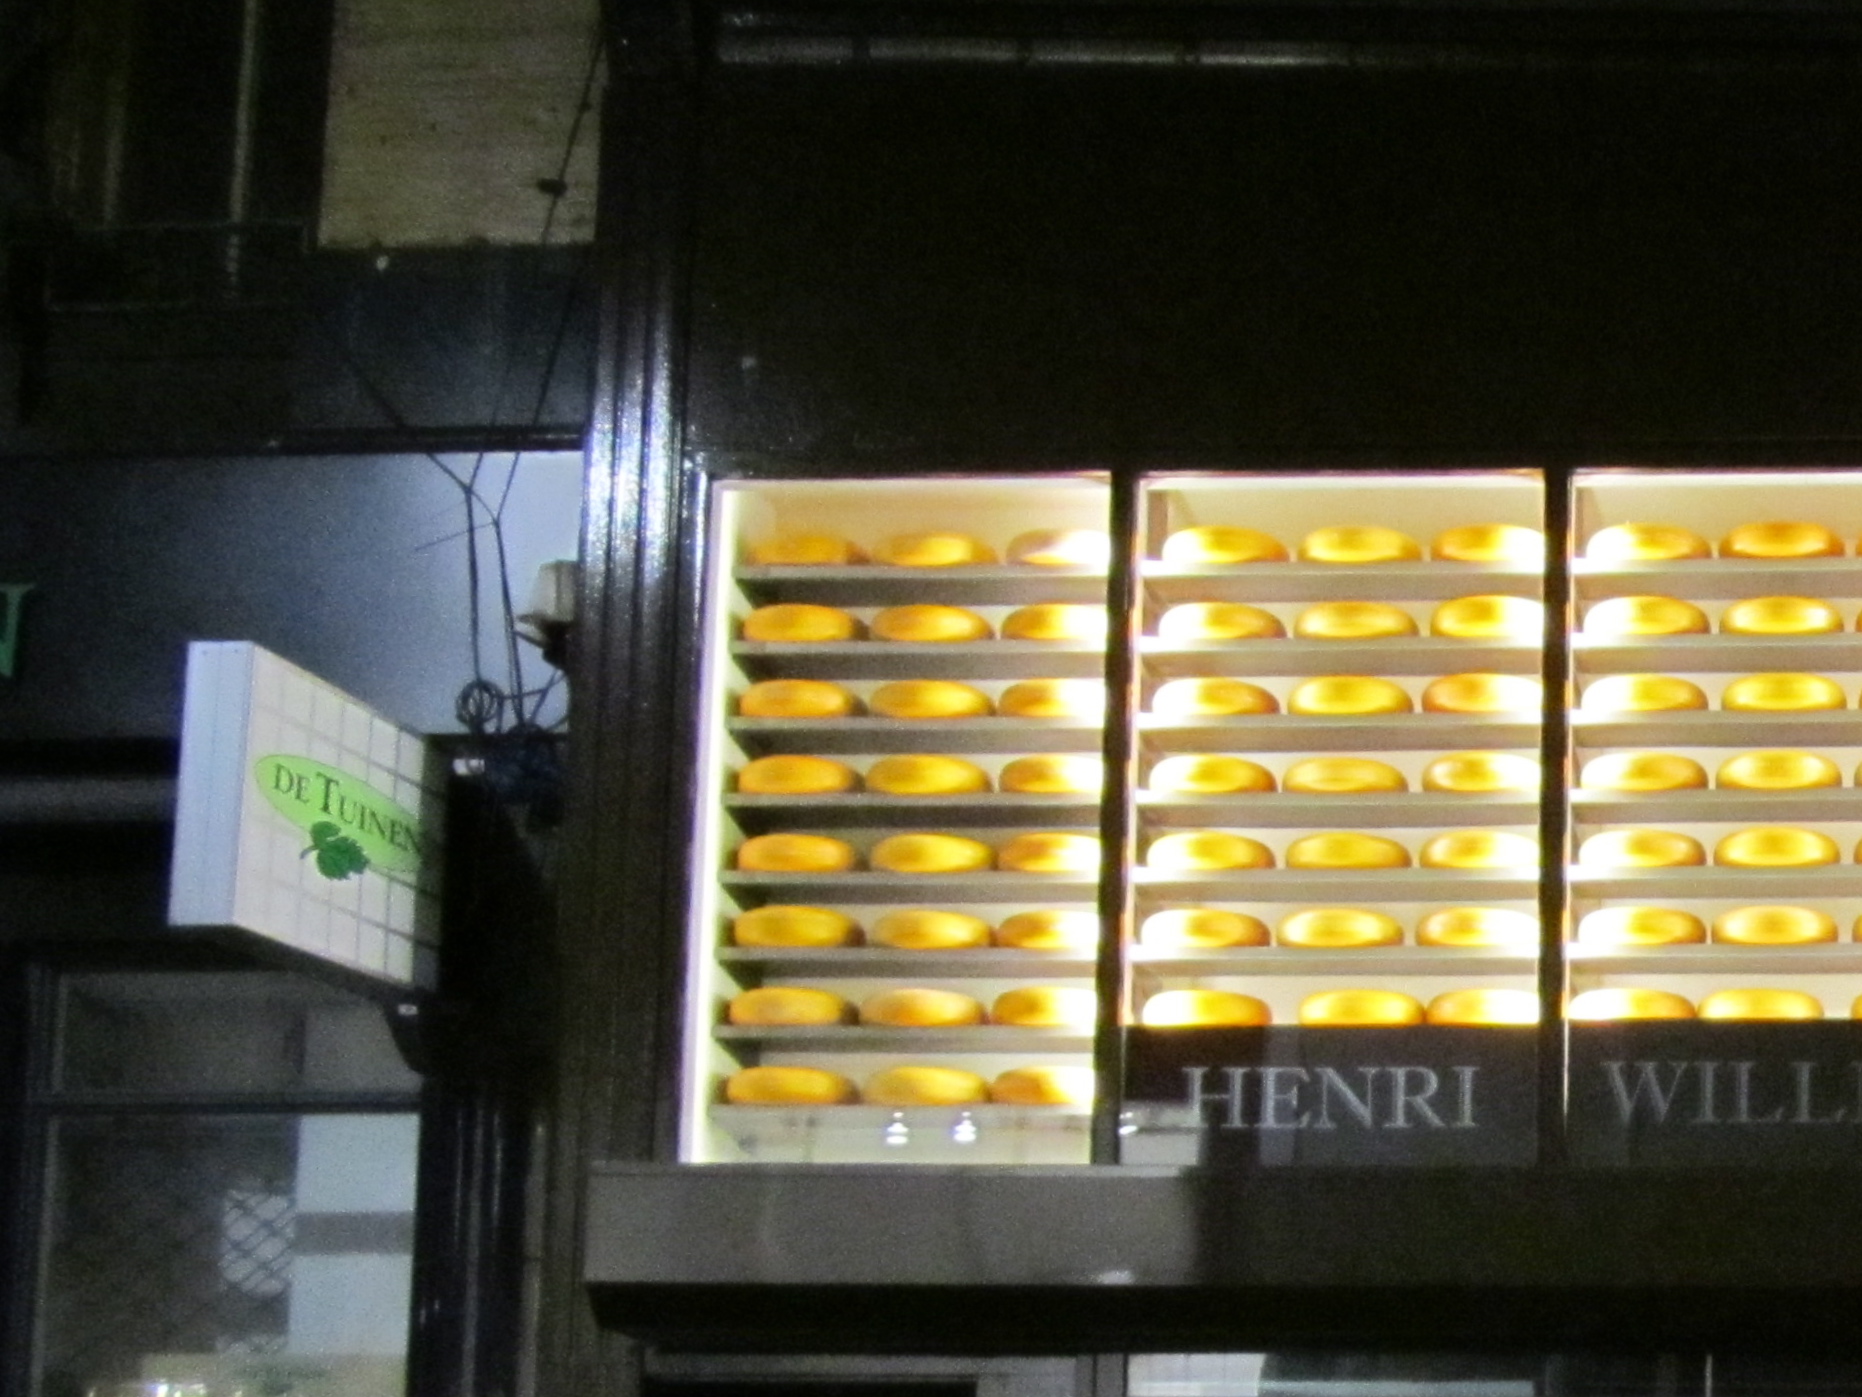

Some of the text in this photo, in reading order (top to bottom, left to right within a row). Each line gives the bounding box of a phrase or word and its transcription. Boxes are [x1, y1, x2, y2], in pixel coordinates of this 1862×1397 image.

[273, 764, 424, 857] DE TUINEN
[1183, 1065, 1480, 1130] HENRI
